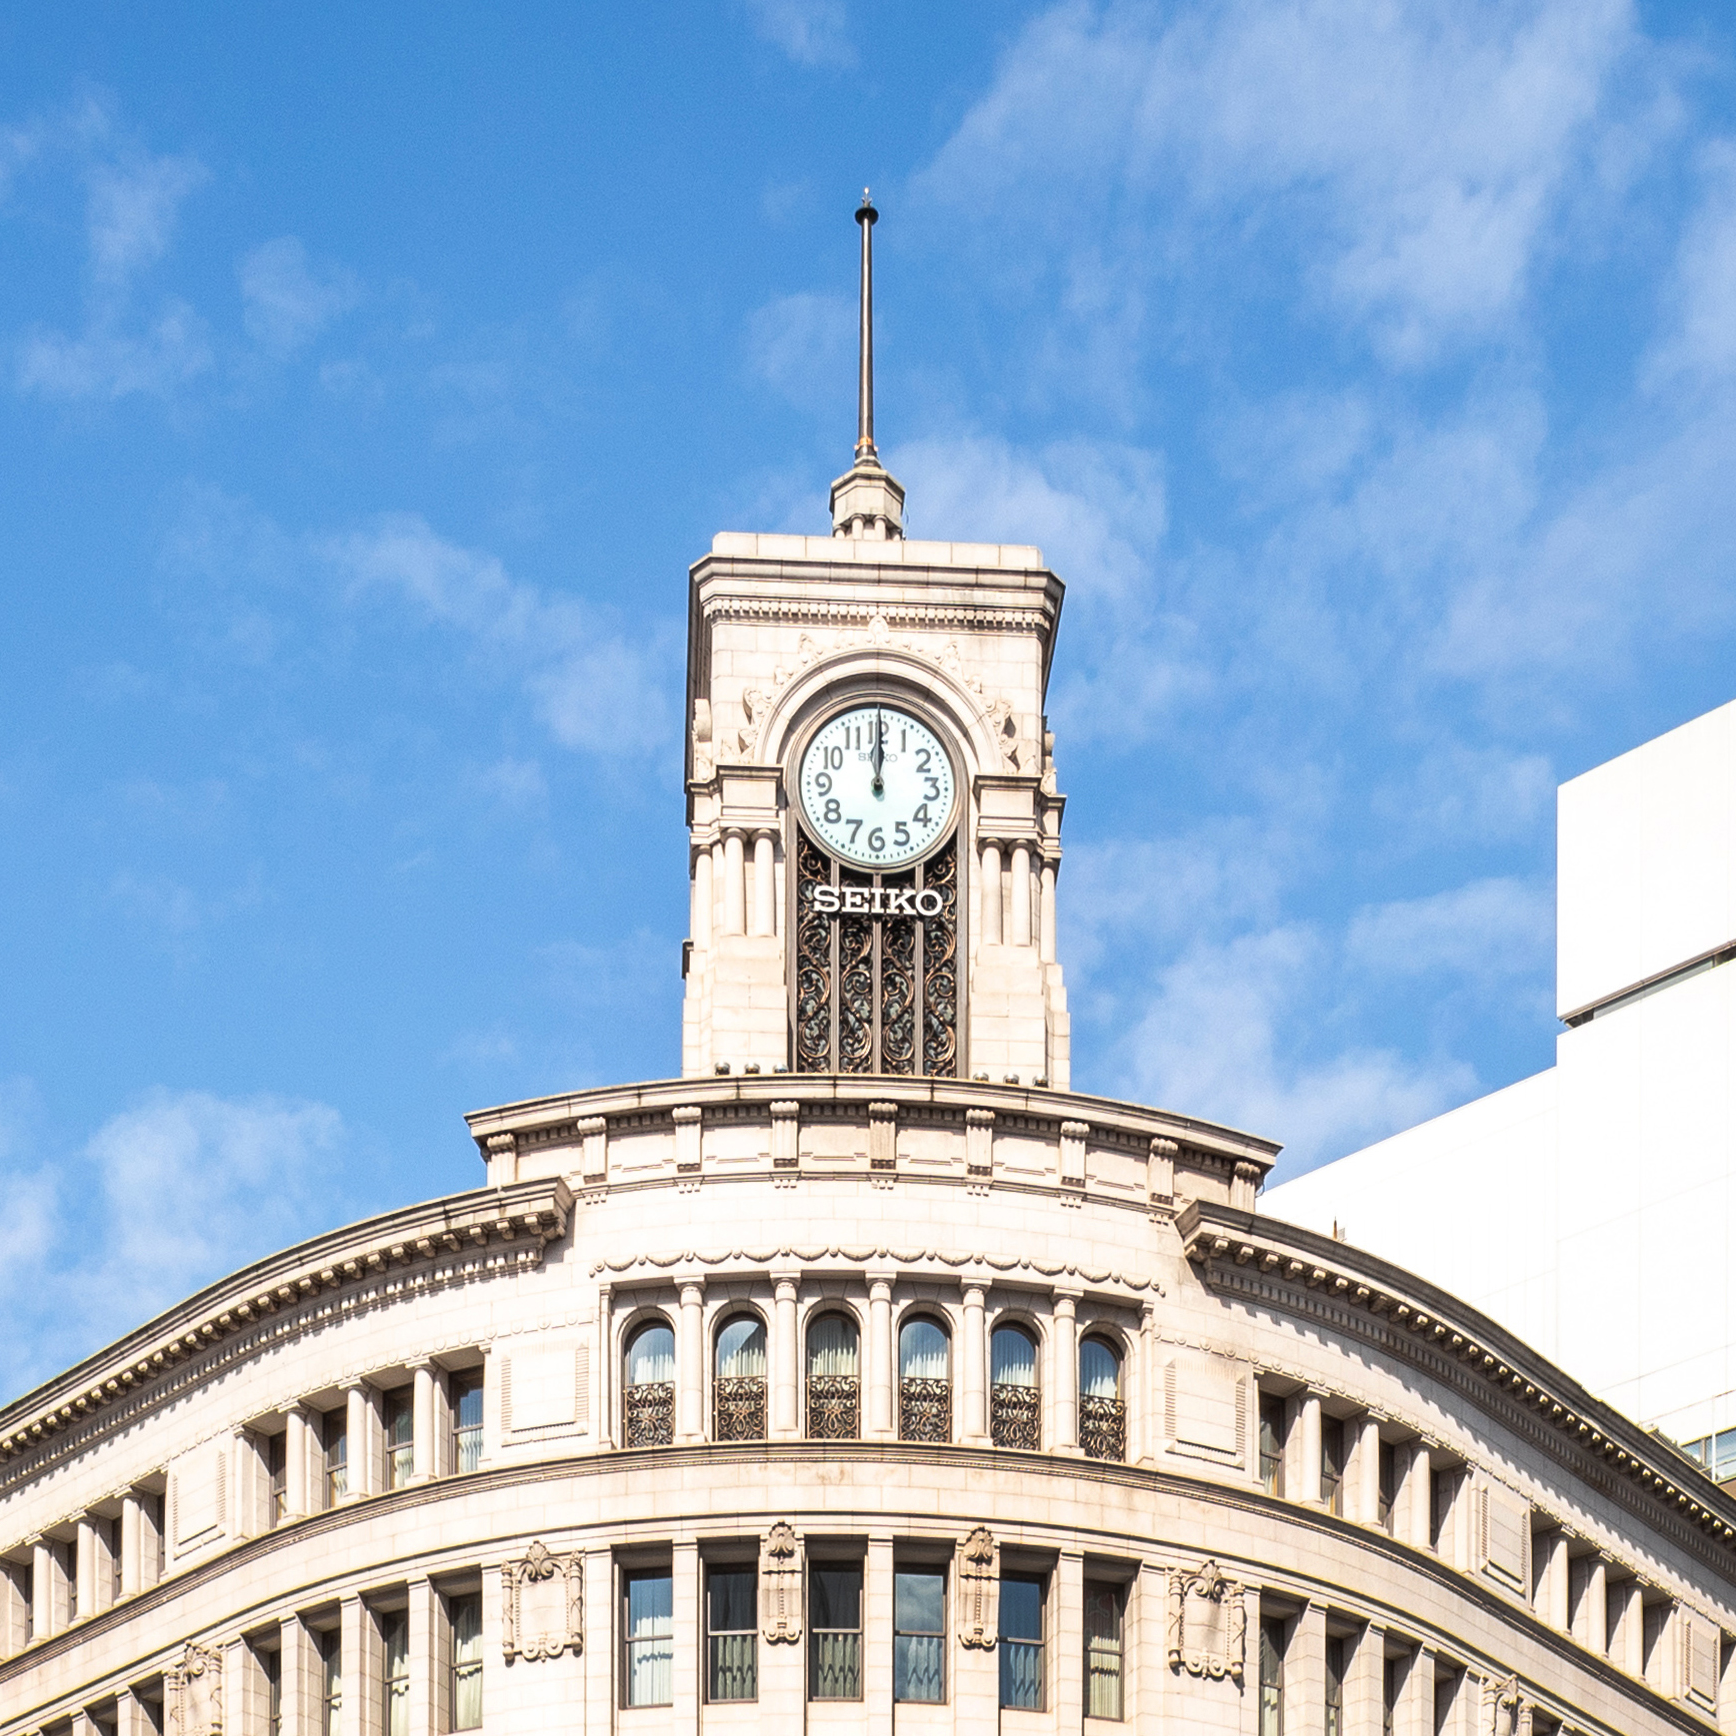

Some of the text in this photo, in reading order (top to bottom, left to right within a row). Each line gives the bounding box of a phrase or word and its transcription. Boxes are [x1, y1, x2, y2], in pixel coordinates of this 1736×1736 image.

[845, 726, 861, 750] 11
[901, 729, 906, 752] 1
[824, 746, 843, 770] 10
[915, 748, 931, 773] 2
[815, 772, 832, 797] 9
[923, 777, 940, 801] 3
[824, 799, 841, 824] 8
[913, 803, 932, 828] 4
[846, 819, 863, 844] 7
[868, 827, 885, 852] 6
[893, 821, 910, 846] 5
[813, 885, 943, 916] SEIKO
